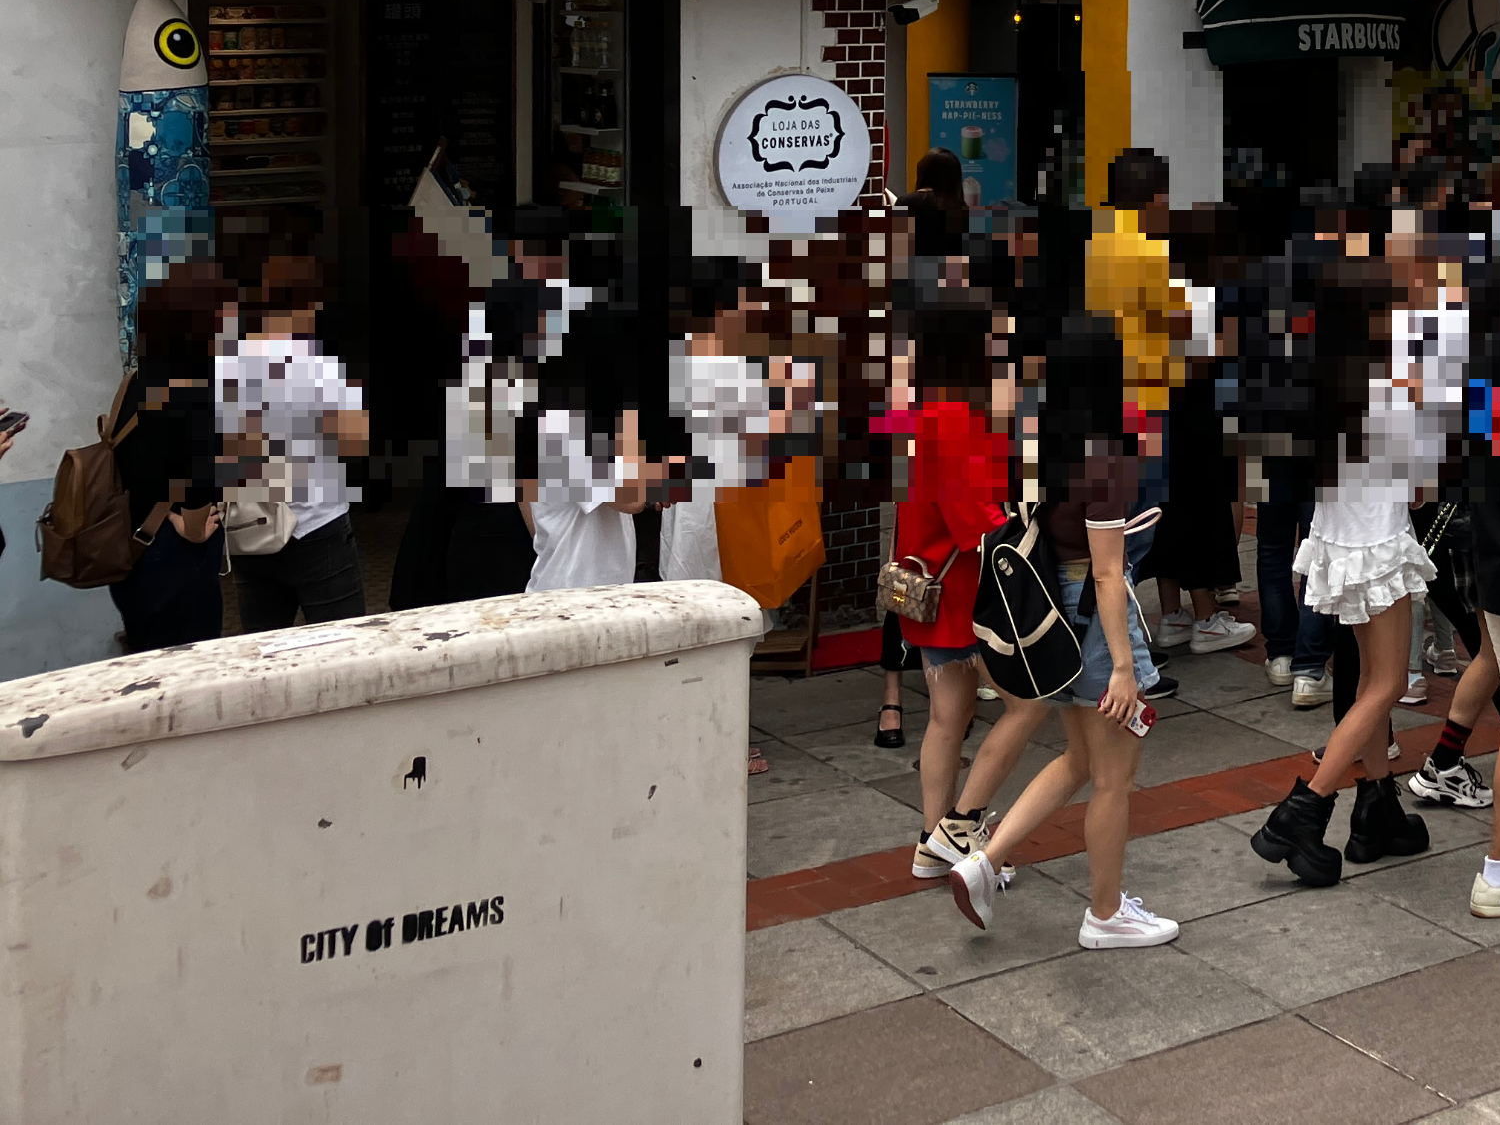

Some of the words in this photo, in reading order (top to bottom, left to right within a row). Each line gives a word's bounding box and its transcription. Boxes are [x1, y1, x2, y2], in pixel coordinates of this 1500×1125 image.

[1298, 23, 1401, 51] STARBUCKS
[944, 100, 1000, 109] STRAWBERRY
[773, 121, 797, 132] LOJA
[801, 119, 820, 131] DAS
[732, 181, 773, 190] Associação
[775, 179, 806, 188] Nacional
[807, 178, 820, 186] dos
[822, 176, 858, 185] Industriais
[757, 190, 766, 198] de
[767, 189, 804, 197] Conservas
[805, 186, 814, 194] de
[815, 186, 835, 194] Peixe
[772, 197, 818, 207] PORTUGAL
[300, 924, 358, 964] CITY
[402, 895, 504, 944] DREAMS
